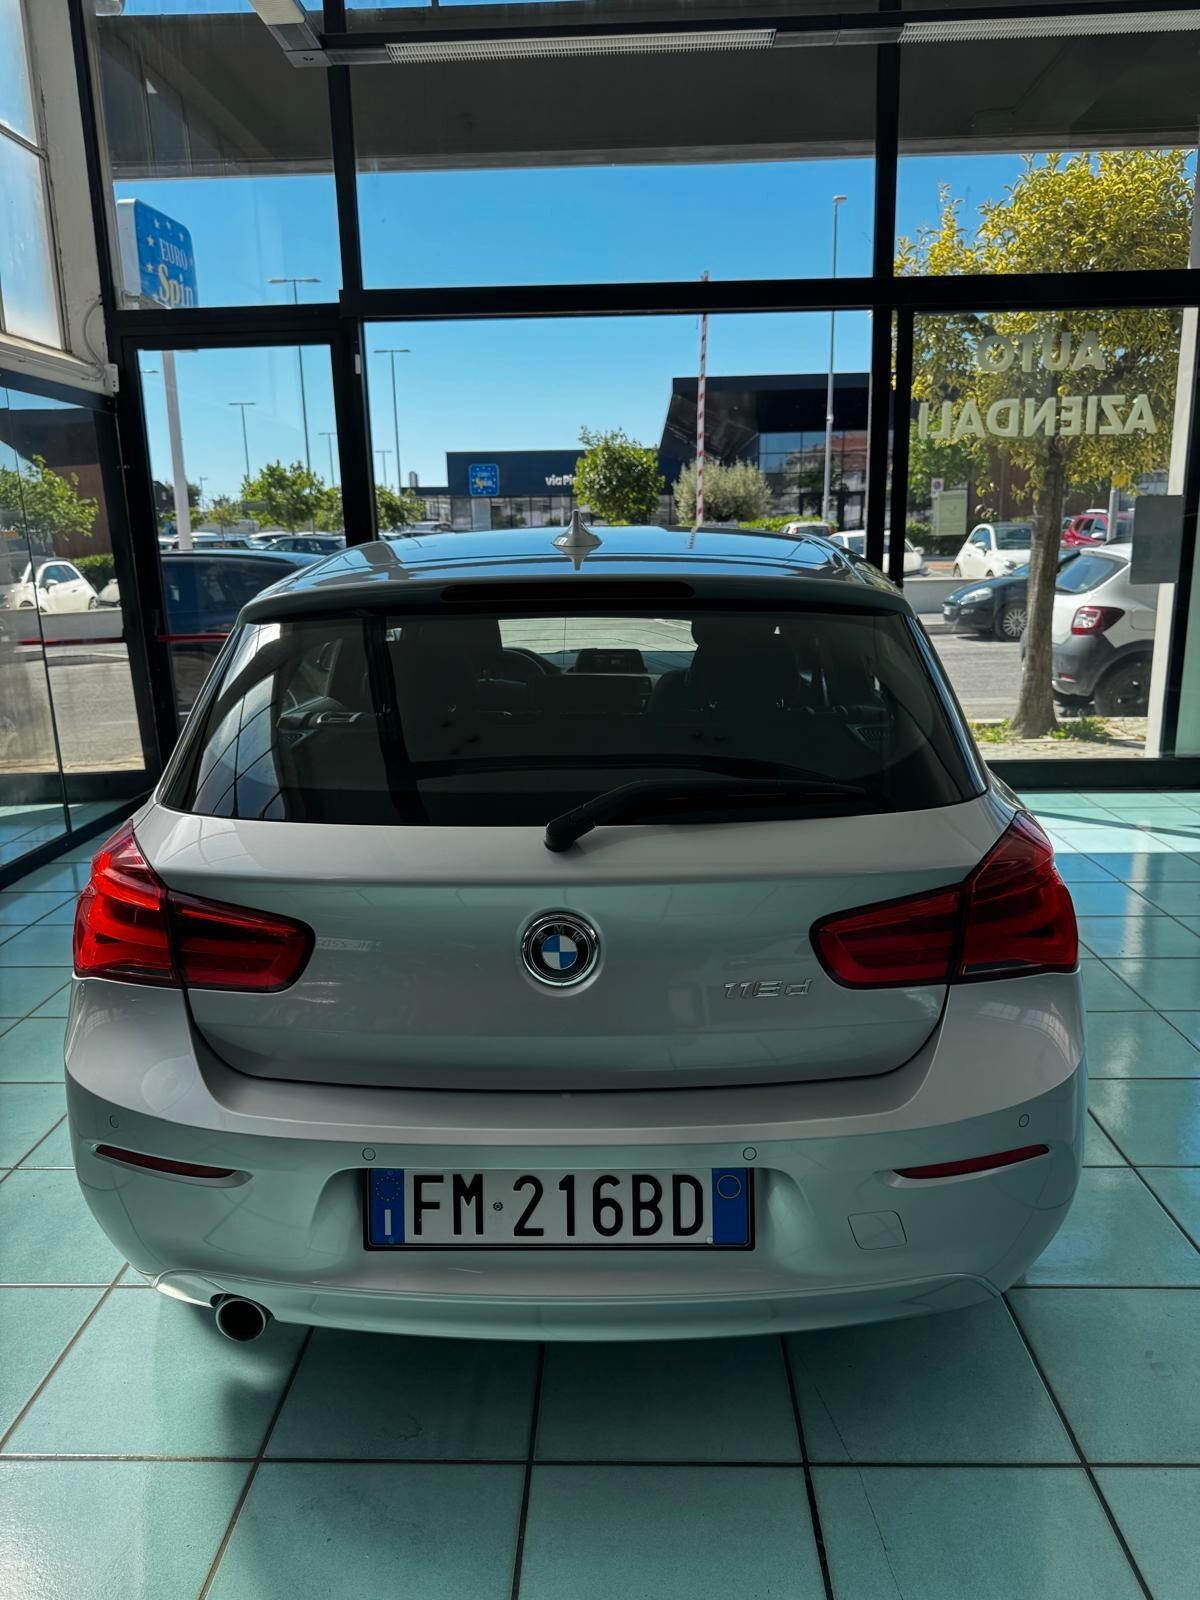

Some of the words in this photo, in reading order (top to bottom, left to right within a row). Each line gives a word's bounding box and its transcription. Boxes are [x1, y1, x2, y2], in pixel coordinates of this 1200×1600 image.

[159, 238, 188, 270] EURO
[158, 263, 193, 308] Spin
[413, 1174, 484, 1235] FM
[513, 1175, 703, 1236] 216BD
